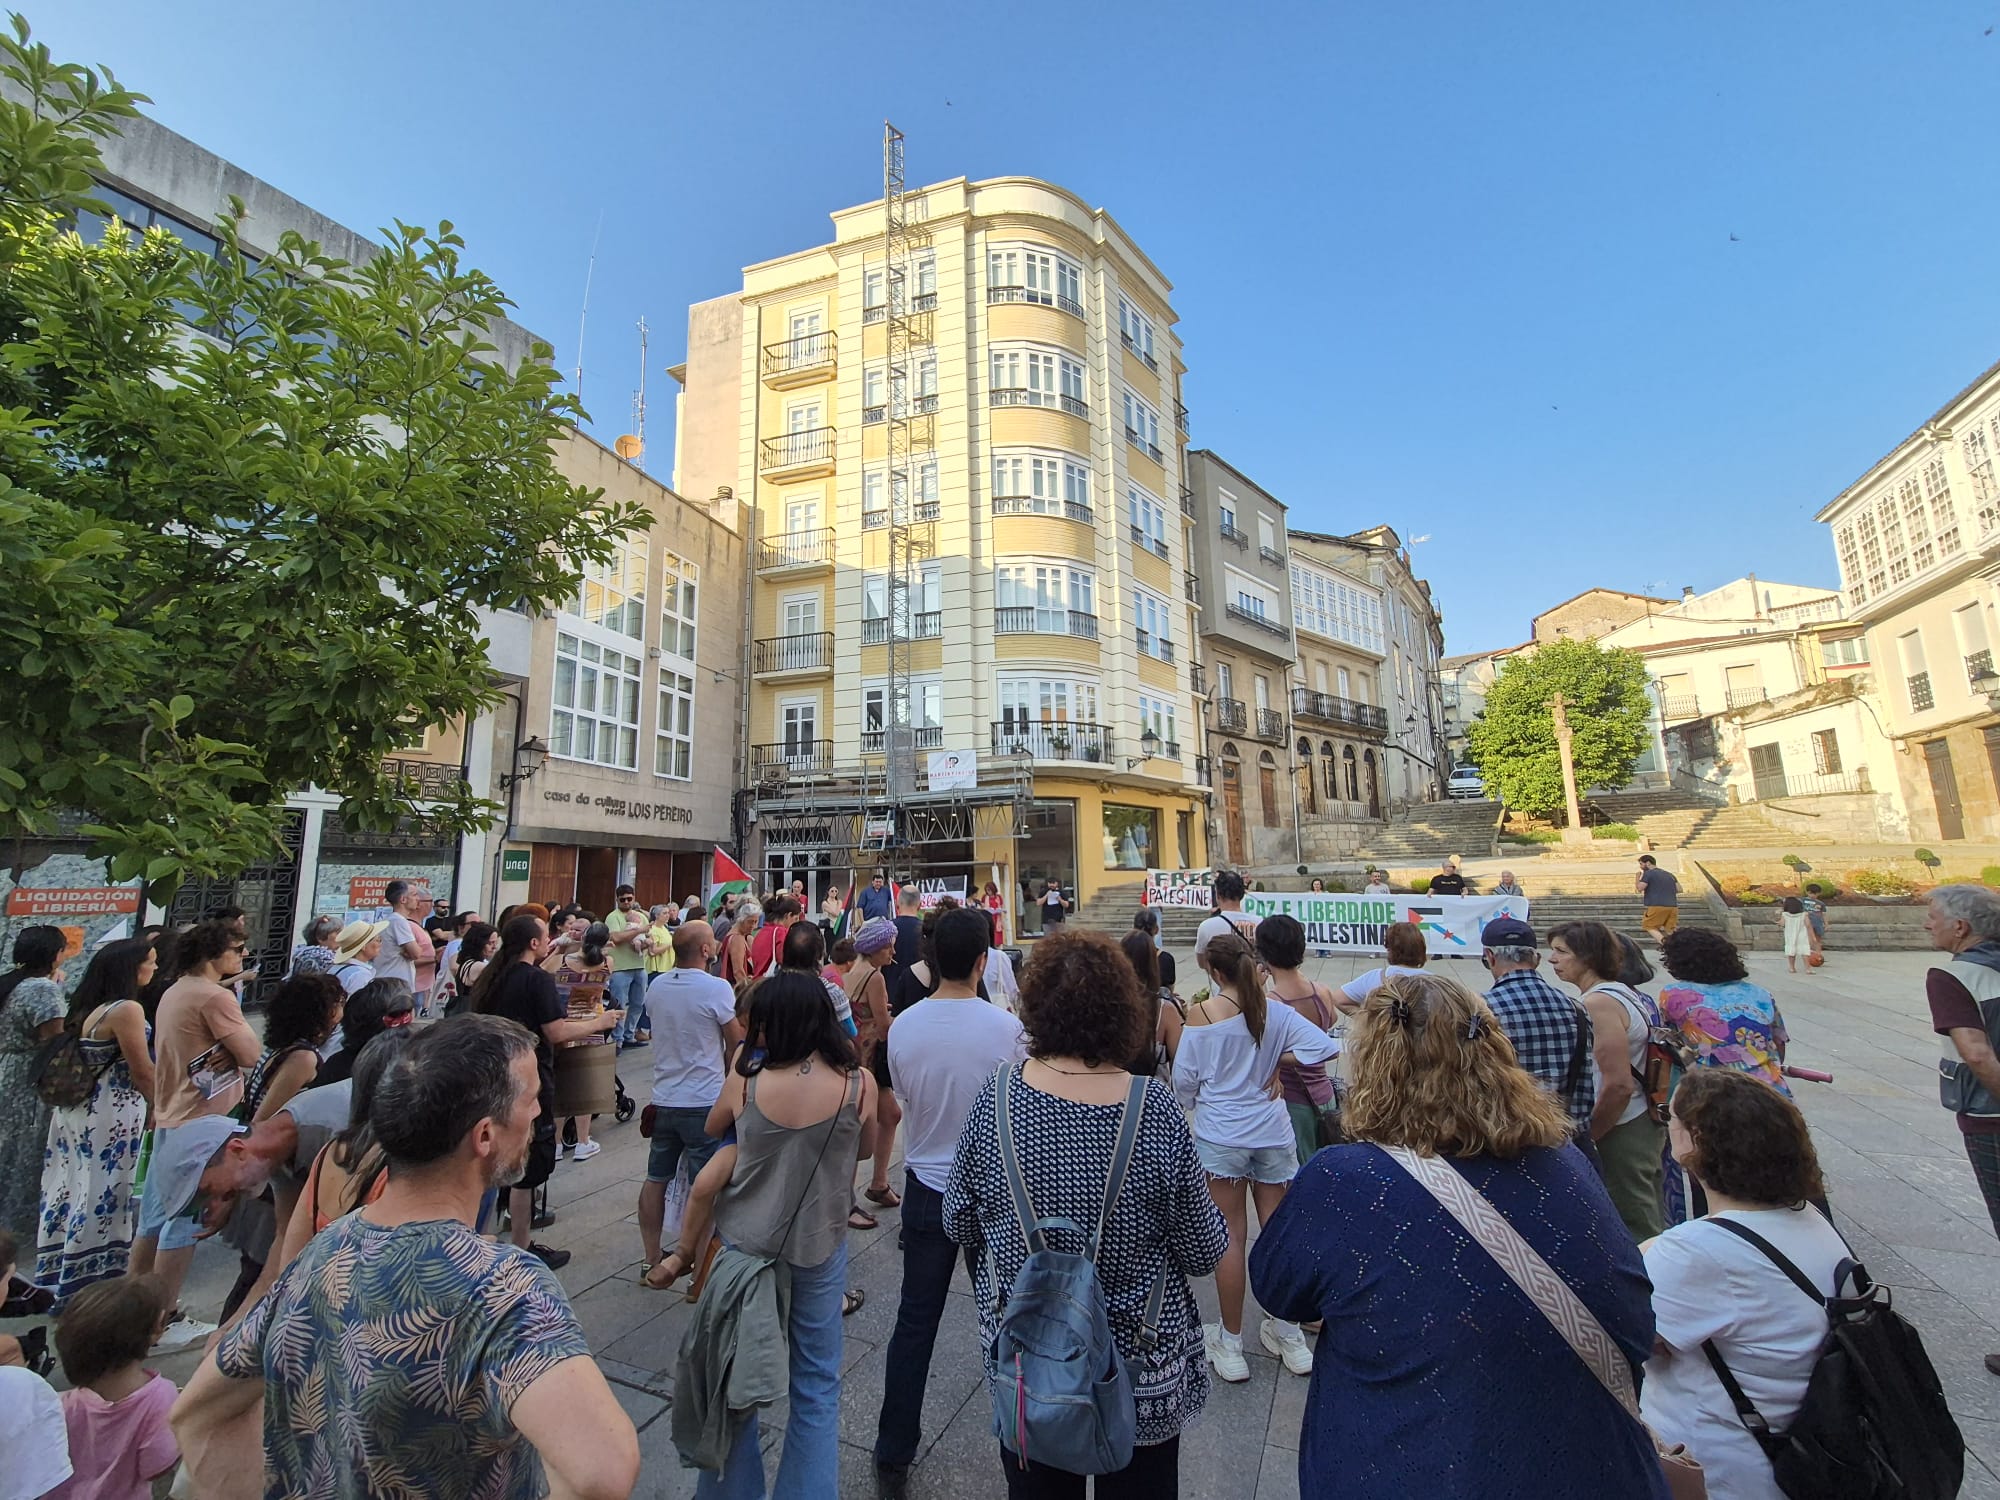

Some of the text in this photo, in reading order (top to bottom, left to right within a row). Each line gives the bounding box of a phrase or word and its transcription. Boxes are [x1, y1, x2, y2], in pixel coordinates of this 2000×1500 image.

[544, 790, 571, 802] casa
[576, 792, 590, 804] da
[628, 802, 651, 819] LOIS
[653, 804, 693, 824] PEREIRO
[505, 860, 528, 870] UNED
[1155, 872, 1212, 887] FREE
[15, 890, 137, 902] LIQUIDACIÓN
[355, 897, 379, 905] POR
[1149, 888, 1209, 906] PALESTINE
[31, 902, 119, 913] LIBRERÍA
[1298, 900, 1396, 923] LIBERDADE
